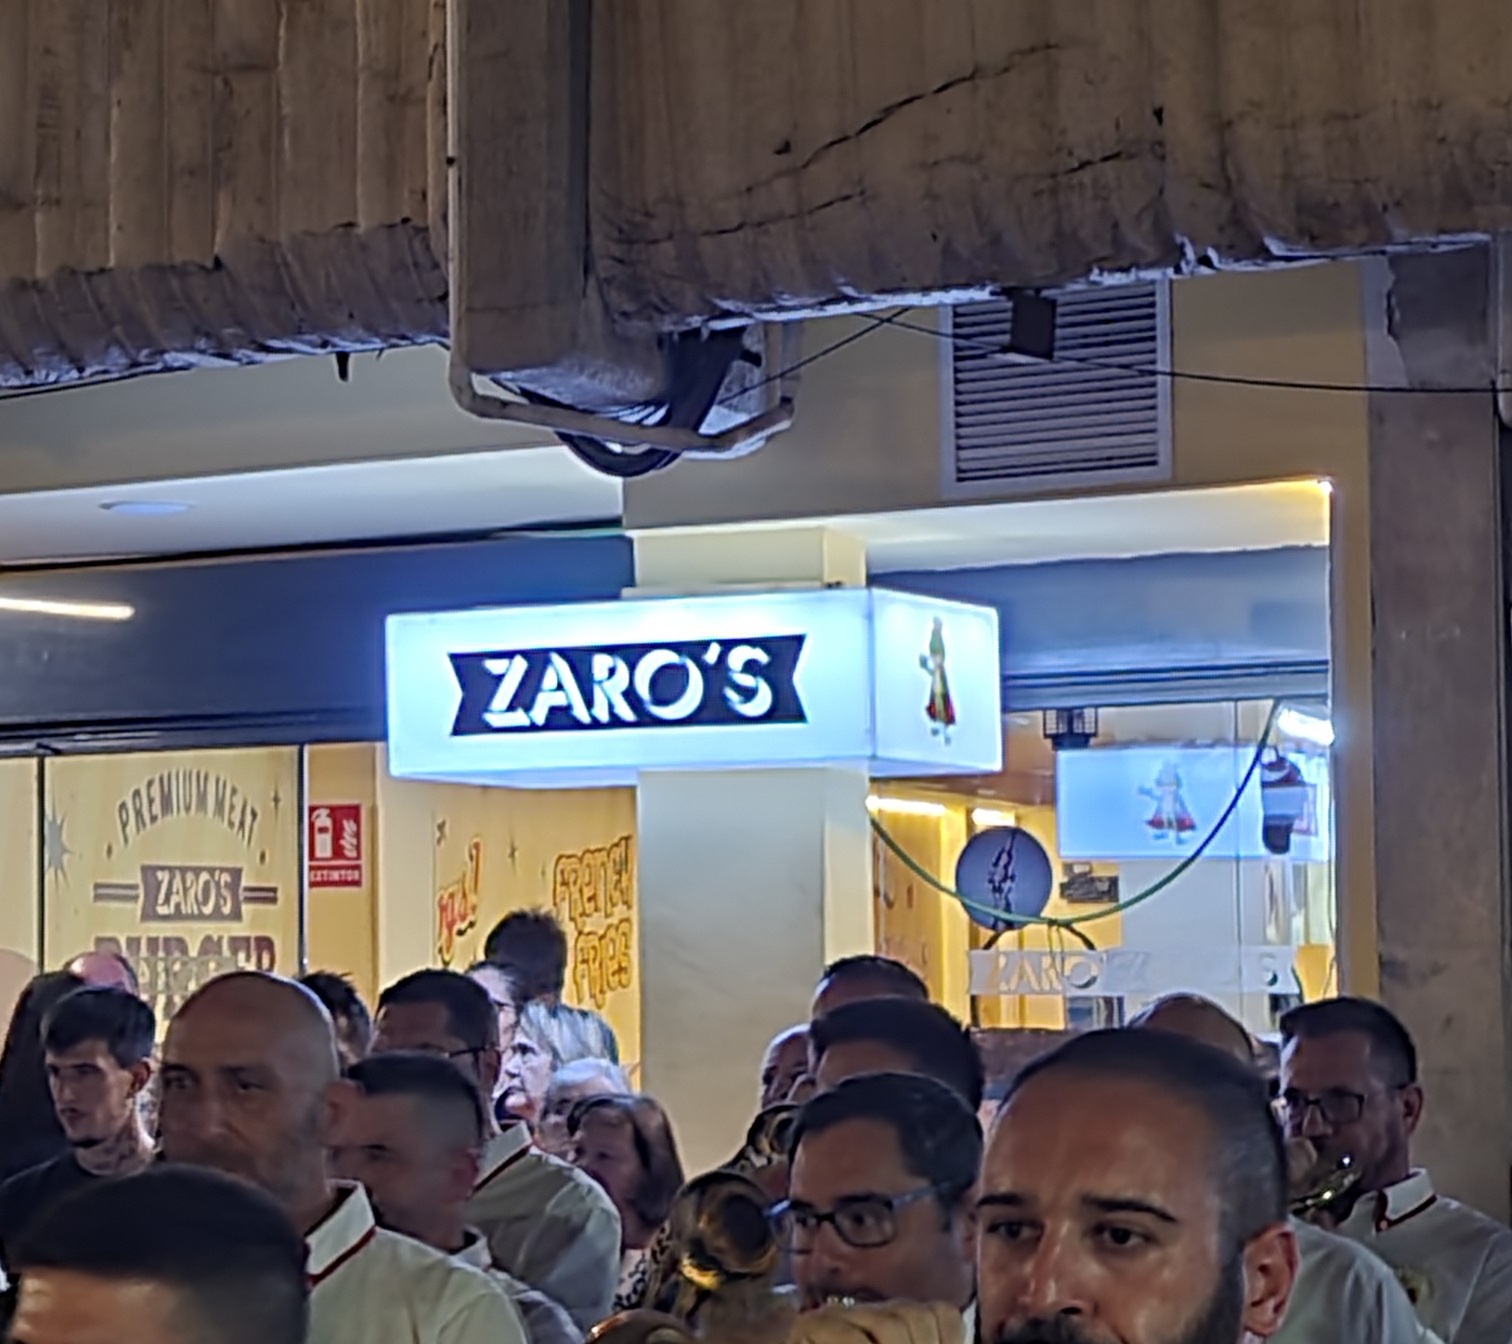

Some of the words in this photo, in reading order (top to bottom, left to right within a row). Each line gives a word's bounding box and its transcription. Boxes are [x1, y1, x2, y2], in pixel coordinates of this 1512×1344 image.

[482, 642, 774, 729] ZARO'S
[118, 767, 209, 845] PREMIUM
[213, 772, 258, 847] MEAT
[155, 869, 232, 916] ZARO'S
[310, 869, 360, 882] EXTINTOR
